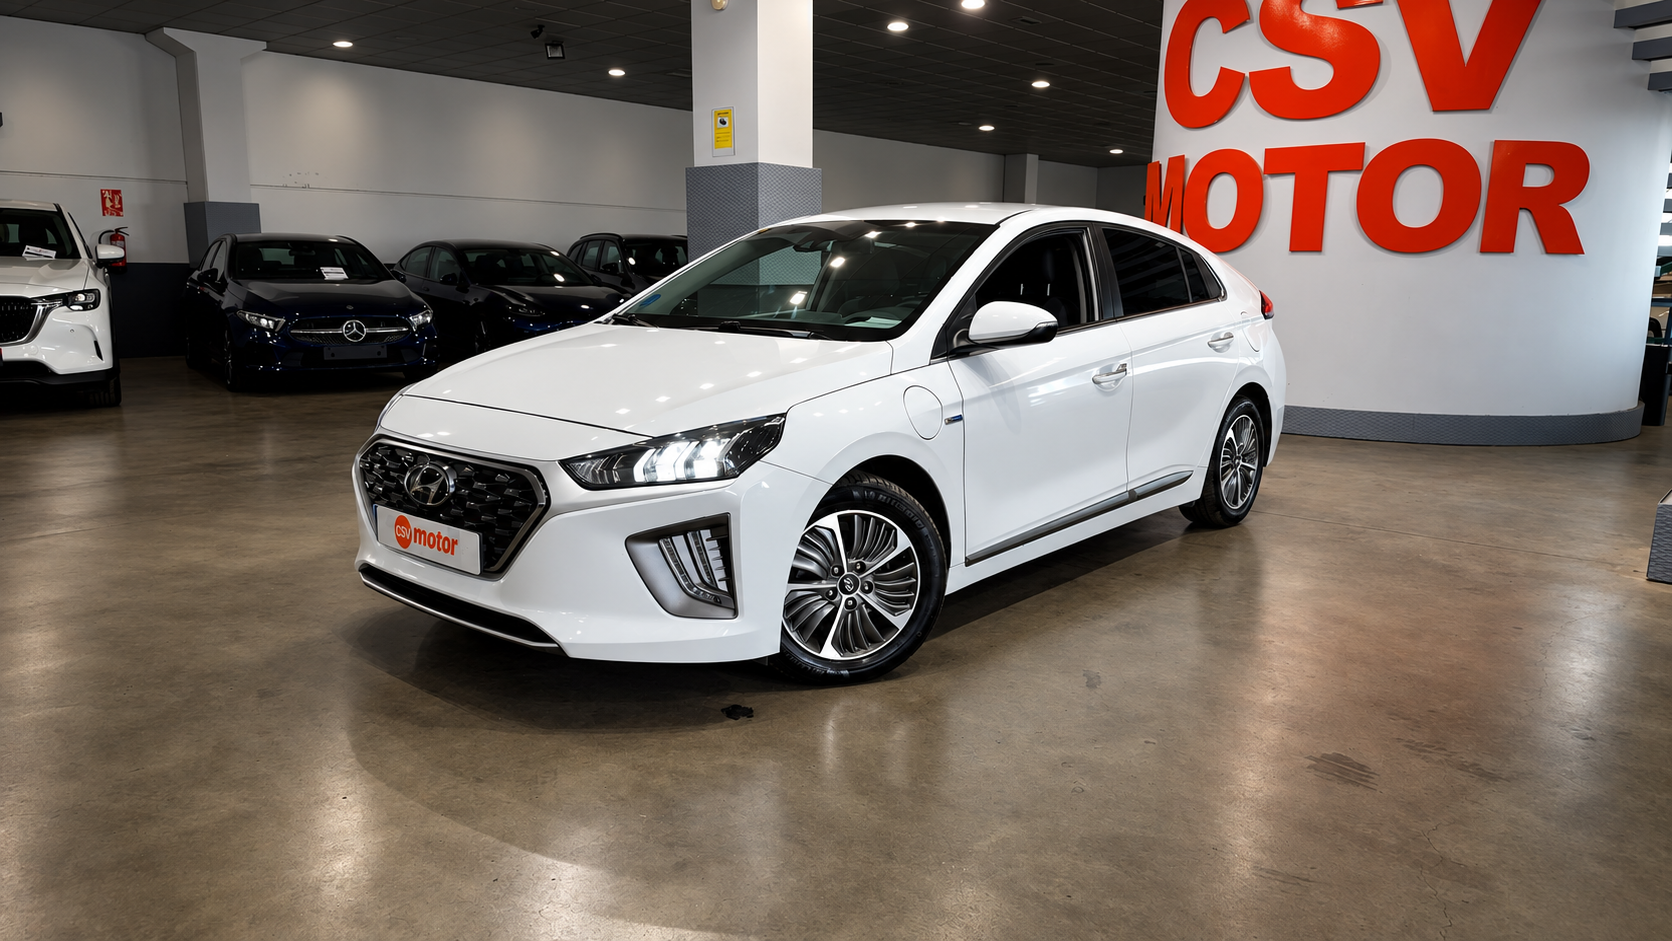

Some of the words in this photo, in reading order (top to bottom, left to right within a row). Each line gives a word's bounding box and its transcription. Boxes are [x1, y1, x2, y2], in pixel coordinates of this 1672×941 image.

[1164, 0, 1541, 128] CSV
[1145, 138, 1590, 255] MOTOR
[413, 527, 458, 555] motor
